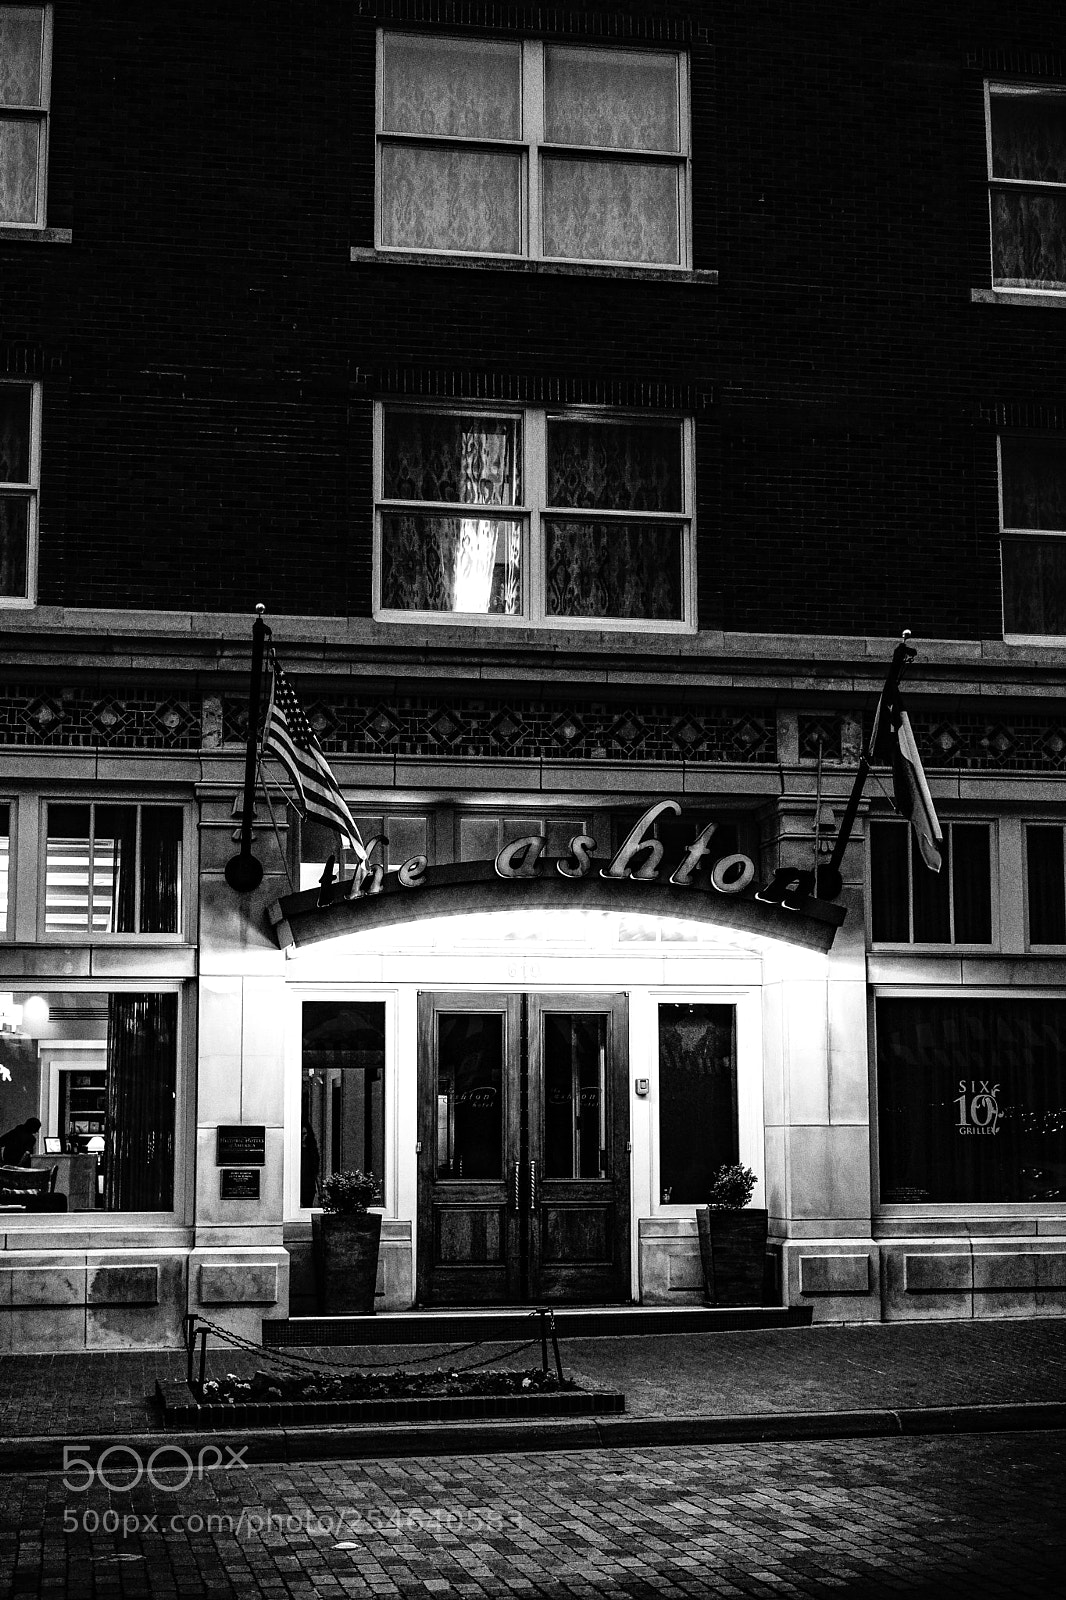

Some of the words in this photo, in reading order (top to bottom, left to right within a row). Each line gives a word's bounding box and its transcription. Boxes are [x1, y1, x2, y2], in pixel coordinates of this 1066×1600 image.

[495, 799, 807, 912] ashton
[958, 1080, 990, 1093] SIX
[953, 1094, 999, 1126] 10
[959, 1127, 994, 1135] GRILLE
